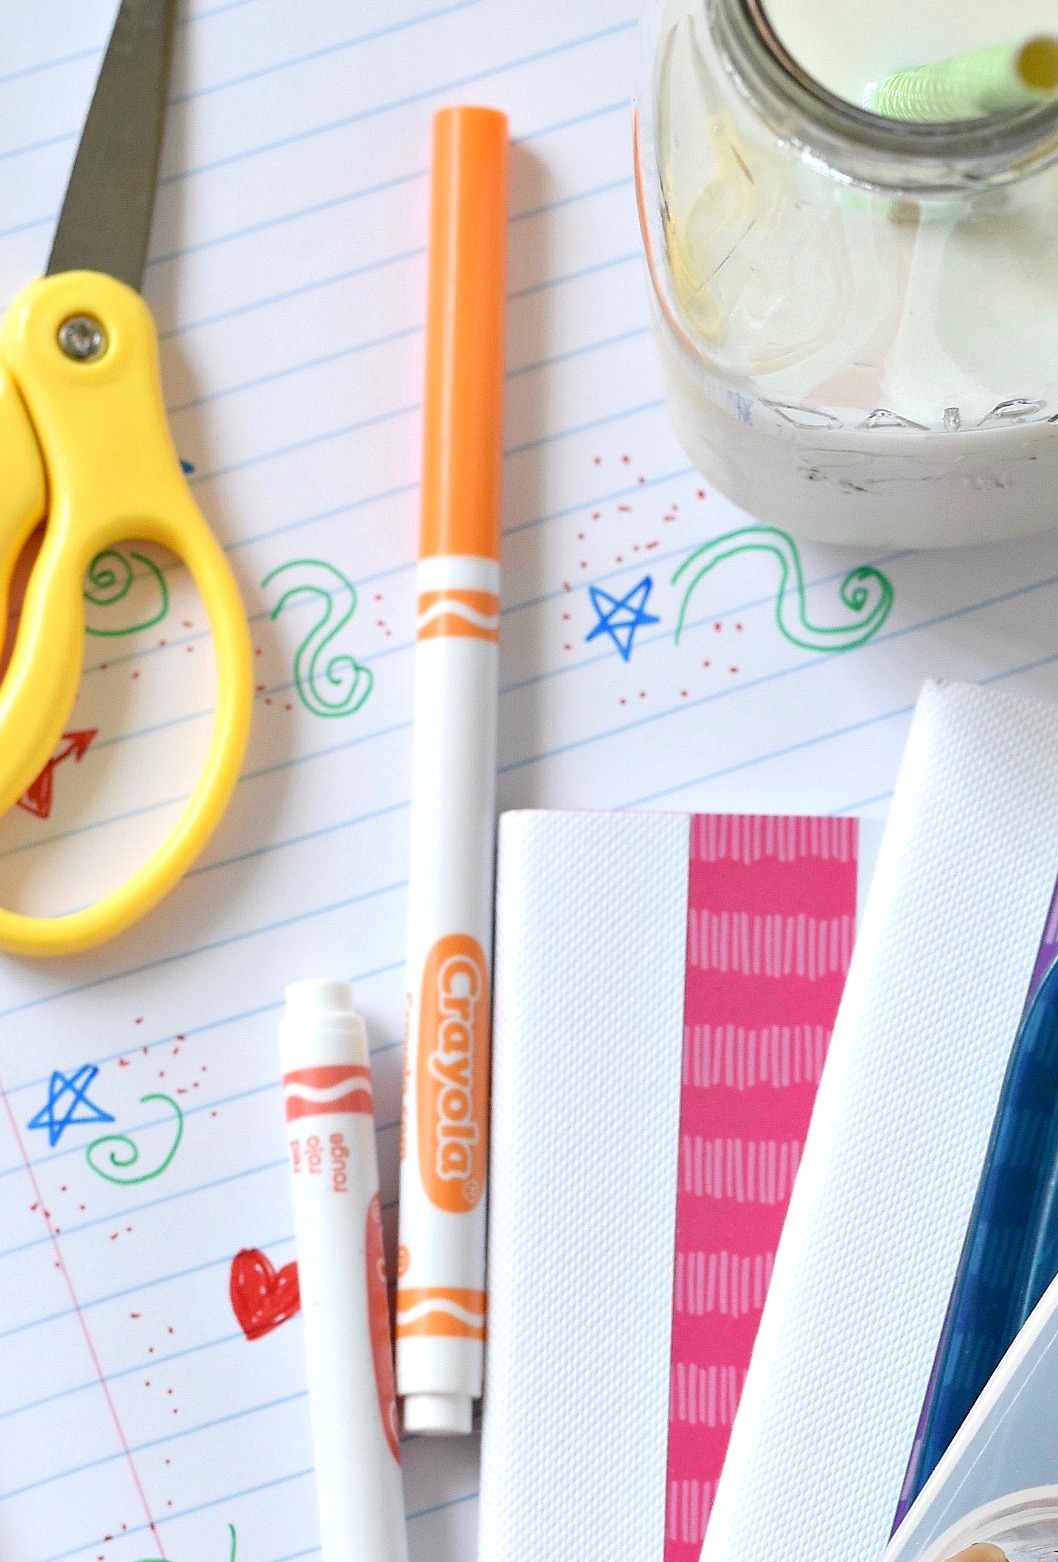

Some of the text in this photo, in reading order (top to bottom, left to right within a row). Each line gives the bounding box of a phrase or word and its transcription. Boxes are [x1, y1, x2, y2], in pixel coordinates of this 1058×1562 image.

[428, 954, 482, 1181] Crayola
[305, 1134, 322, 1175] rojo
[329, 1131, 350, 1193] rouge
